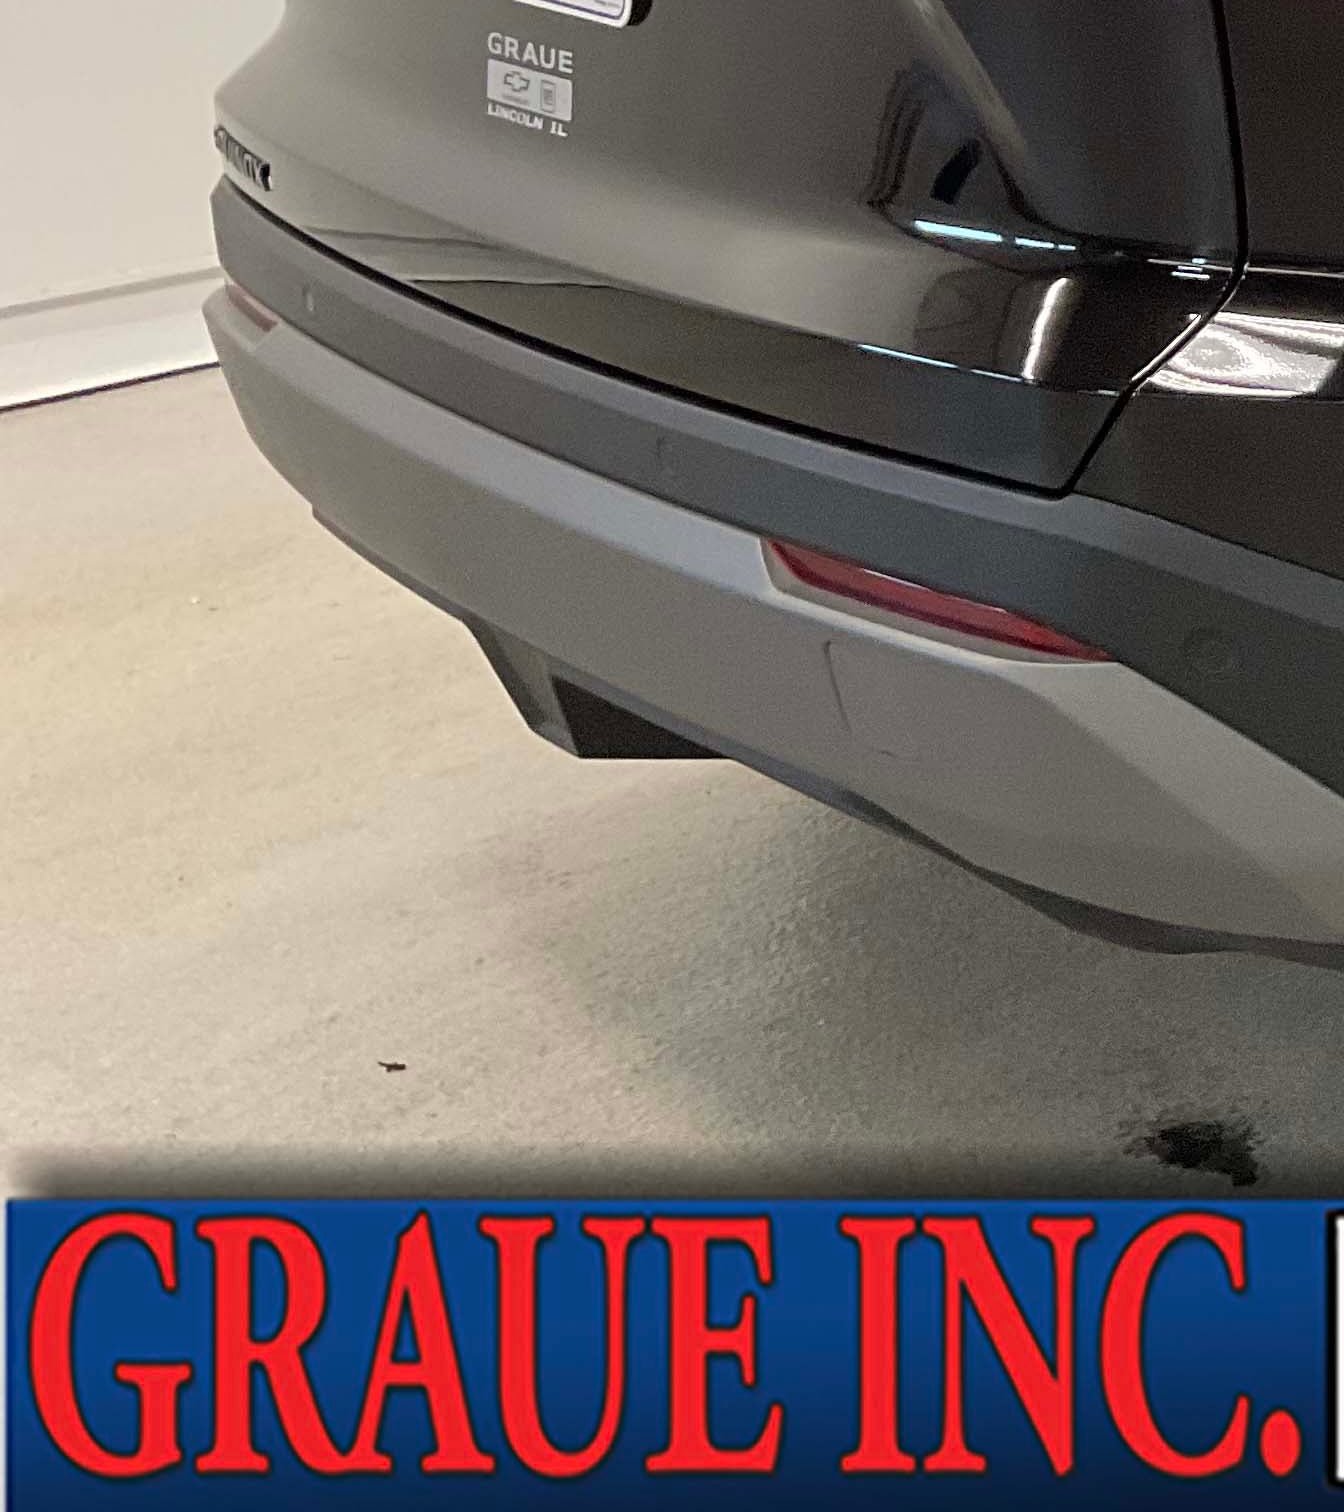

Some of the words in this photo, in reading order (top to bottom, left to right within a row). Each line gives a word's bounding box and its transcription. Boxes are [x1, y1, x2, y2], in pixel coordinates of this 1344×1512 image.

[487, 31, 573, 73] GRAUE
[487, 102, 544, 131] LINCOLN
[550, 119, 568, 137] IL
